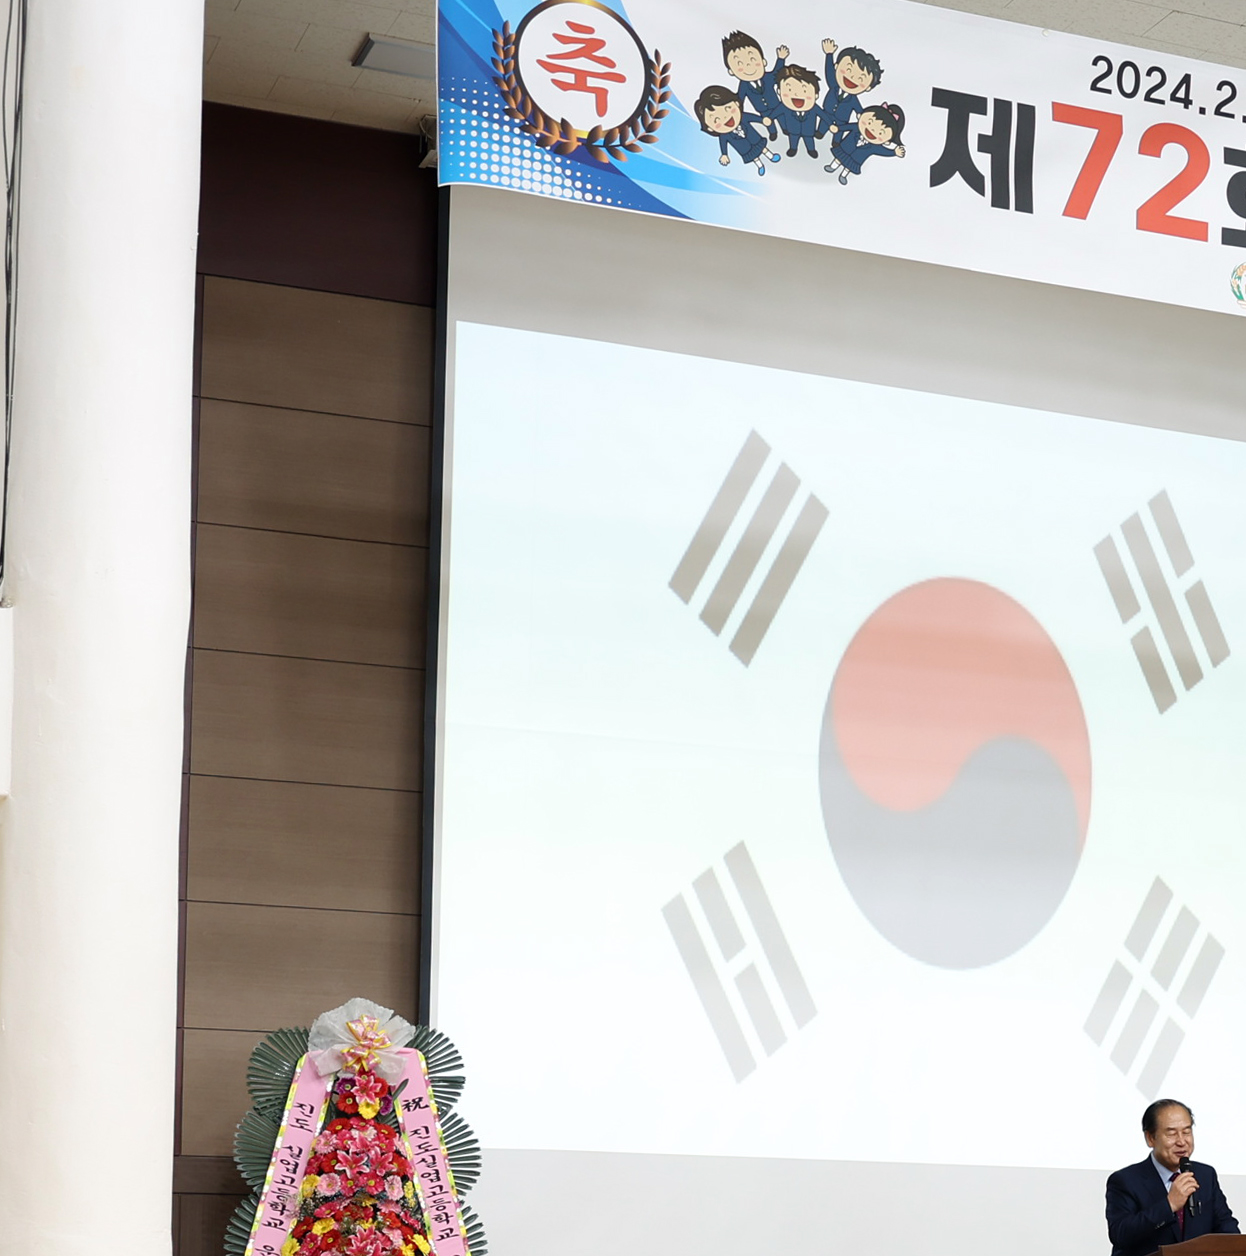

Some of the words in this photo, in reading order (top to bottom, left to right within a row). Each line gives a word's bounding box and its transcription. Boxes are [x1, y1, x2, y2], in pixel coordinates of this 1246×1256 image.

[536, 20, 627, 118] 축
[289, 1101, 315, 1134] 진도
[402, 1096, 430, 1113] 祝
[409, 1125, 460, 1242] 진도실업고등학교
